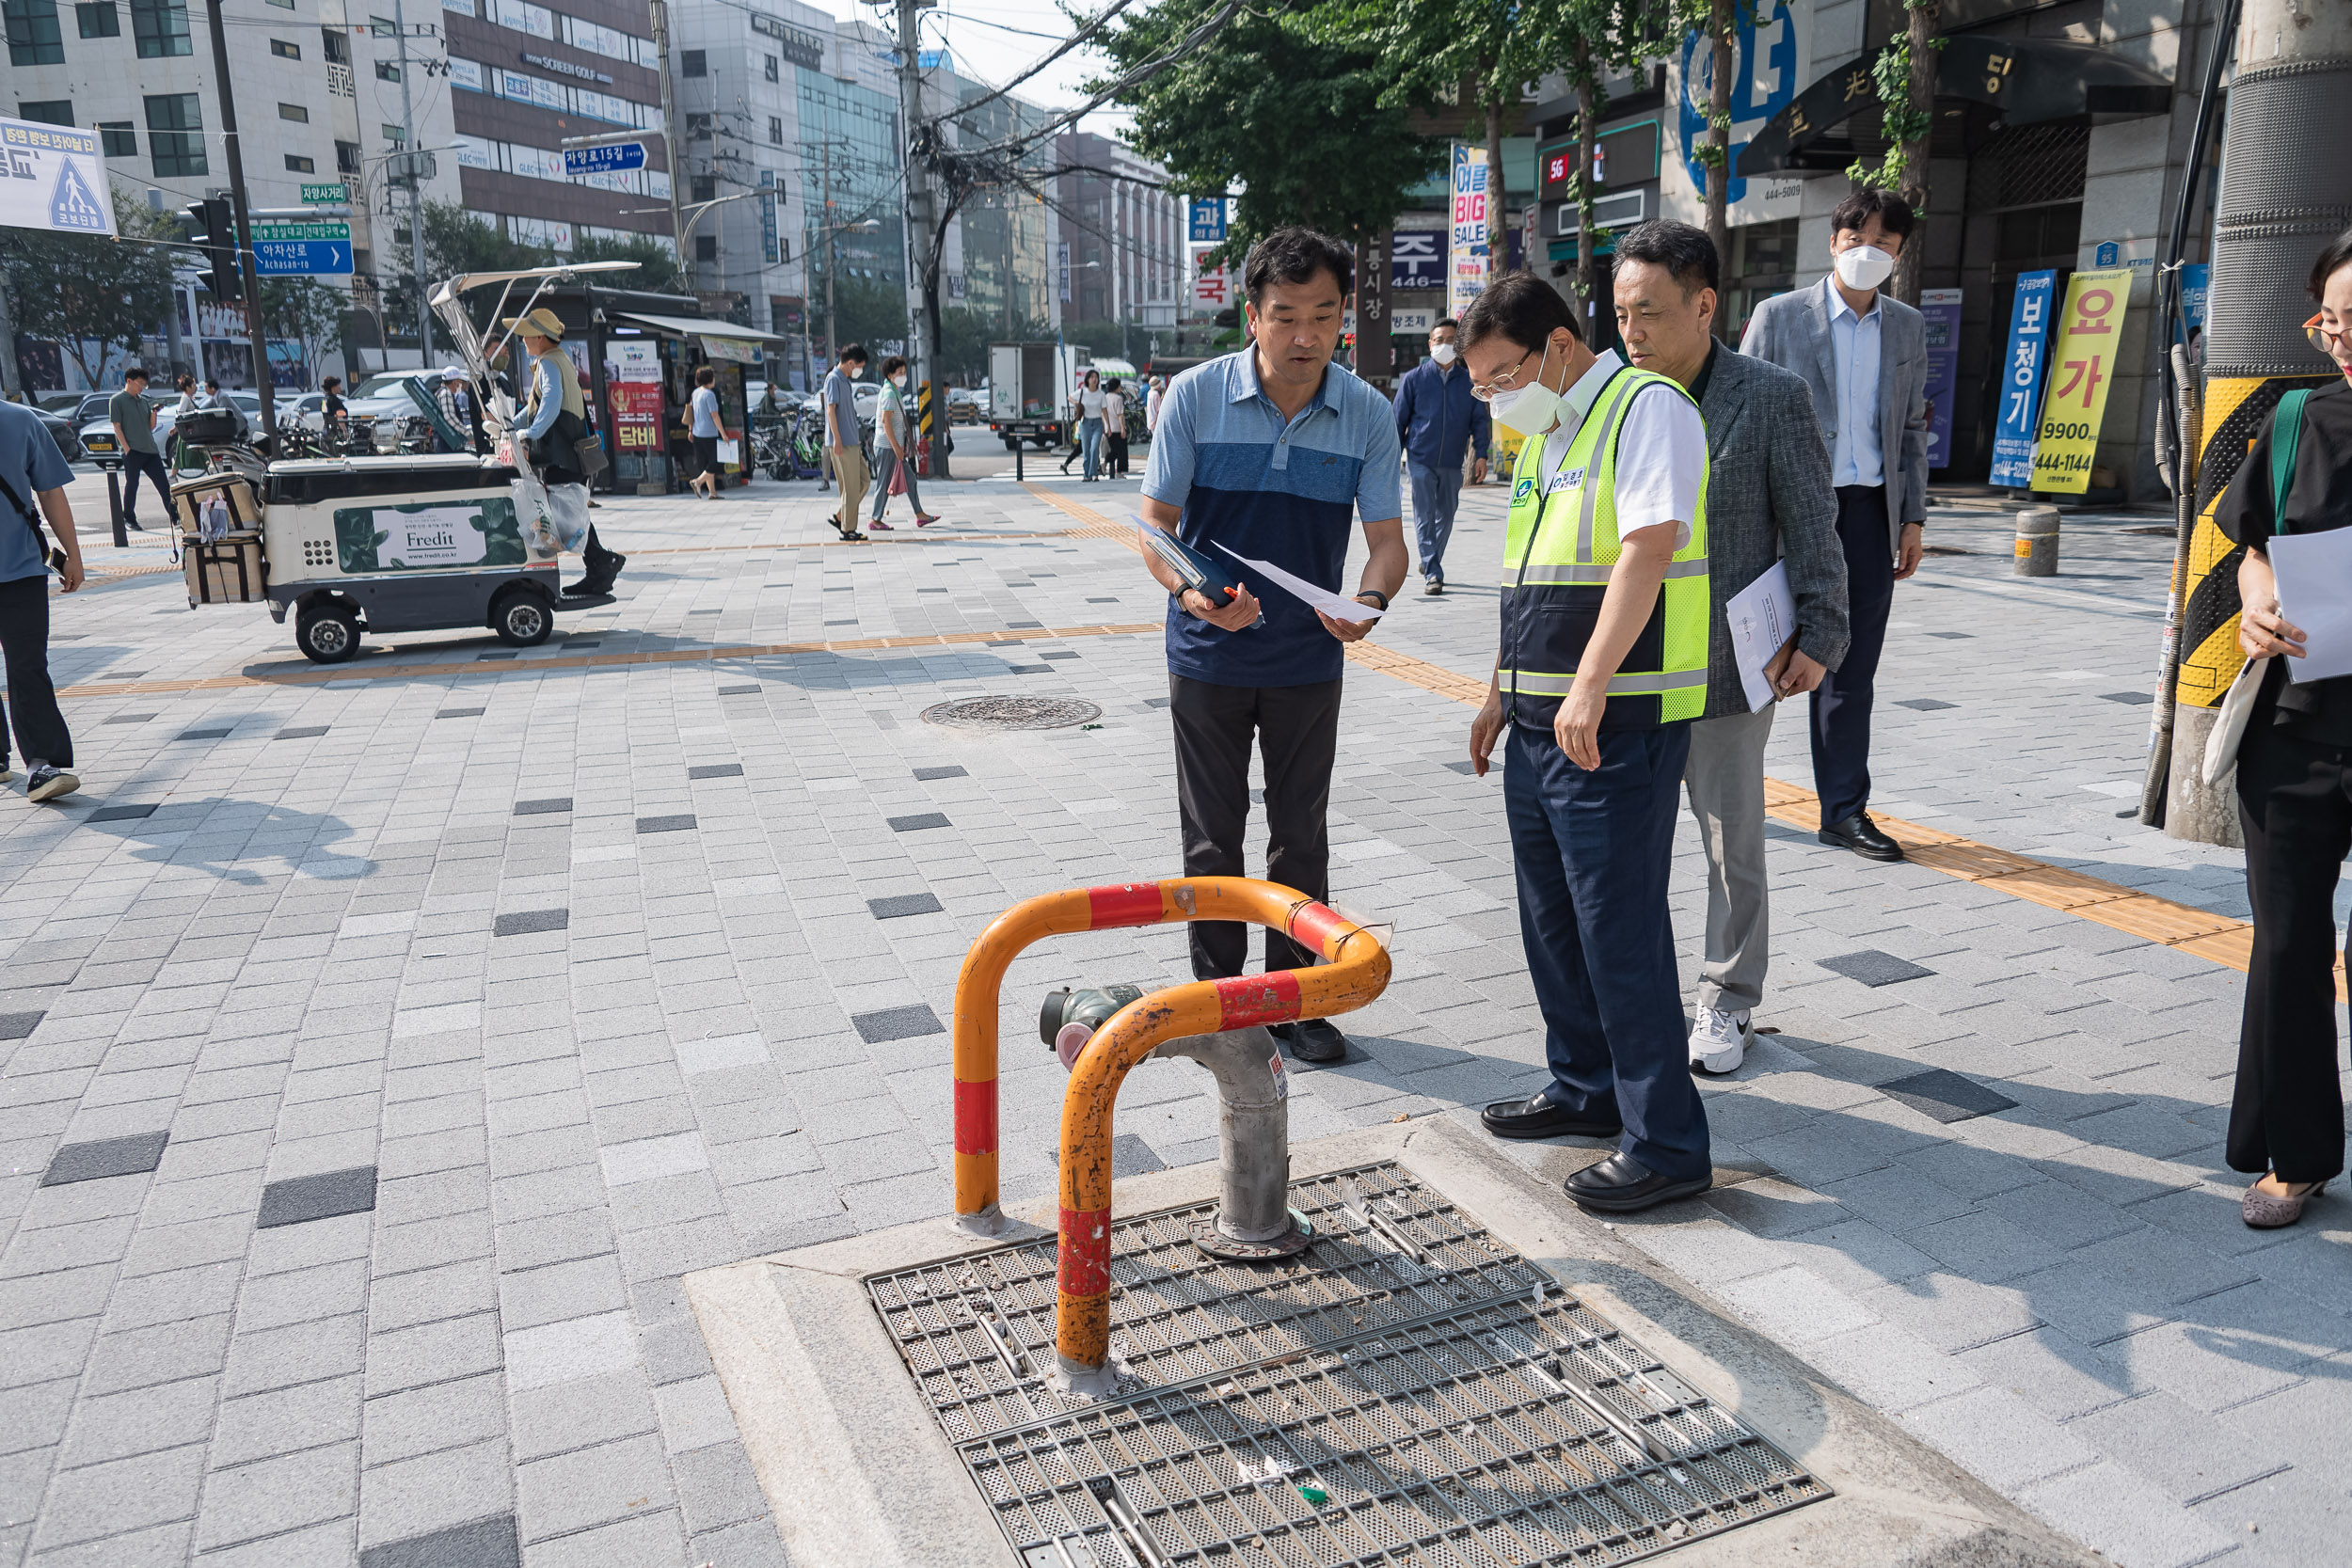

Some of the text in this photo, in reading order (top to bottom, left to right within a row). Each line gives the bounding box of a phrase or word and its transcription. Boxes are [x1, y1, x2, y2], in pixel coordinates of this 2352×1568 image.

[543, 56, 575, 75] SCREEN
[575, 65, 596, 81] GOLF
[1986, 54, 2012, 94] 딩
[1551, 158, 1564, 179] 5G
[1456, 164, 1486, 193] 여름
[303, 187, 343, 199] 자양사거리
[1764, 184, 1801, 200] 444-5009
[1455, 194, 1485, 224] BIG
[271, 226, 303, 238] 잠실대교
[306, 227, 339, 237] 건대입구역
[1195, 229, 1219, 239] 의원
[1454, 224, 1485, 245] SALE
[263, 244, 307, 259] 아차산로
[2101, 254, 2112, 263] 95
[264, 260, 310, 269] Achasan-ro
[1391, 276, 1449, 287] 446-
[2047, 289, 2115, 408] 요가
[2005, 294, 2042, 433] 보청기
[619, 426, 656, 447] 담배
[2043, 422, 2090, 439] 9900
[2035, 453, 2091, 471] 444-1144
[406, 531, 453, 546] Fredit
[408, 551, 456, 560] www.fredit.co.kr
